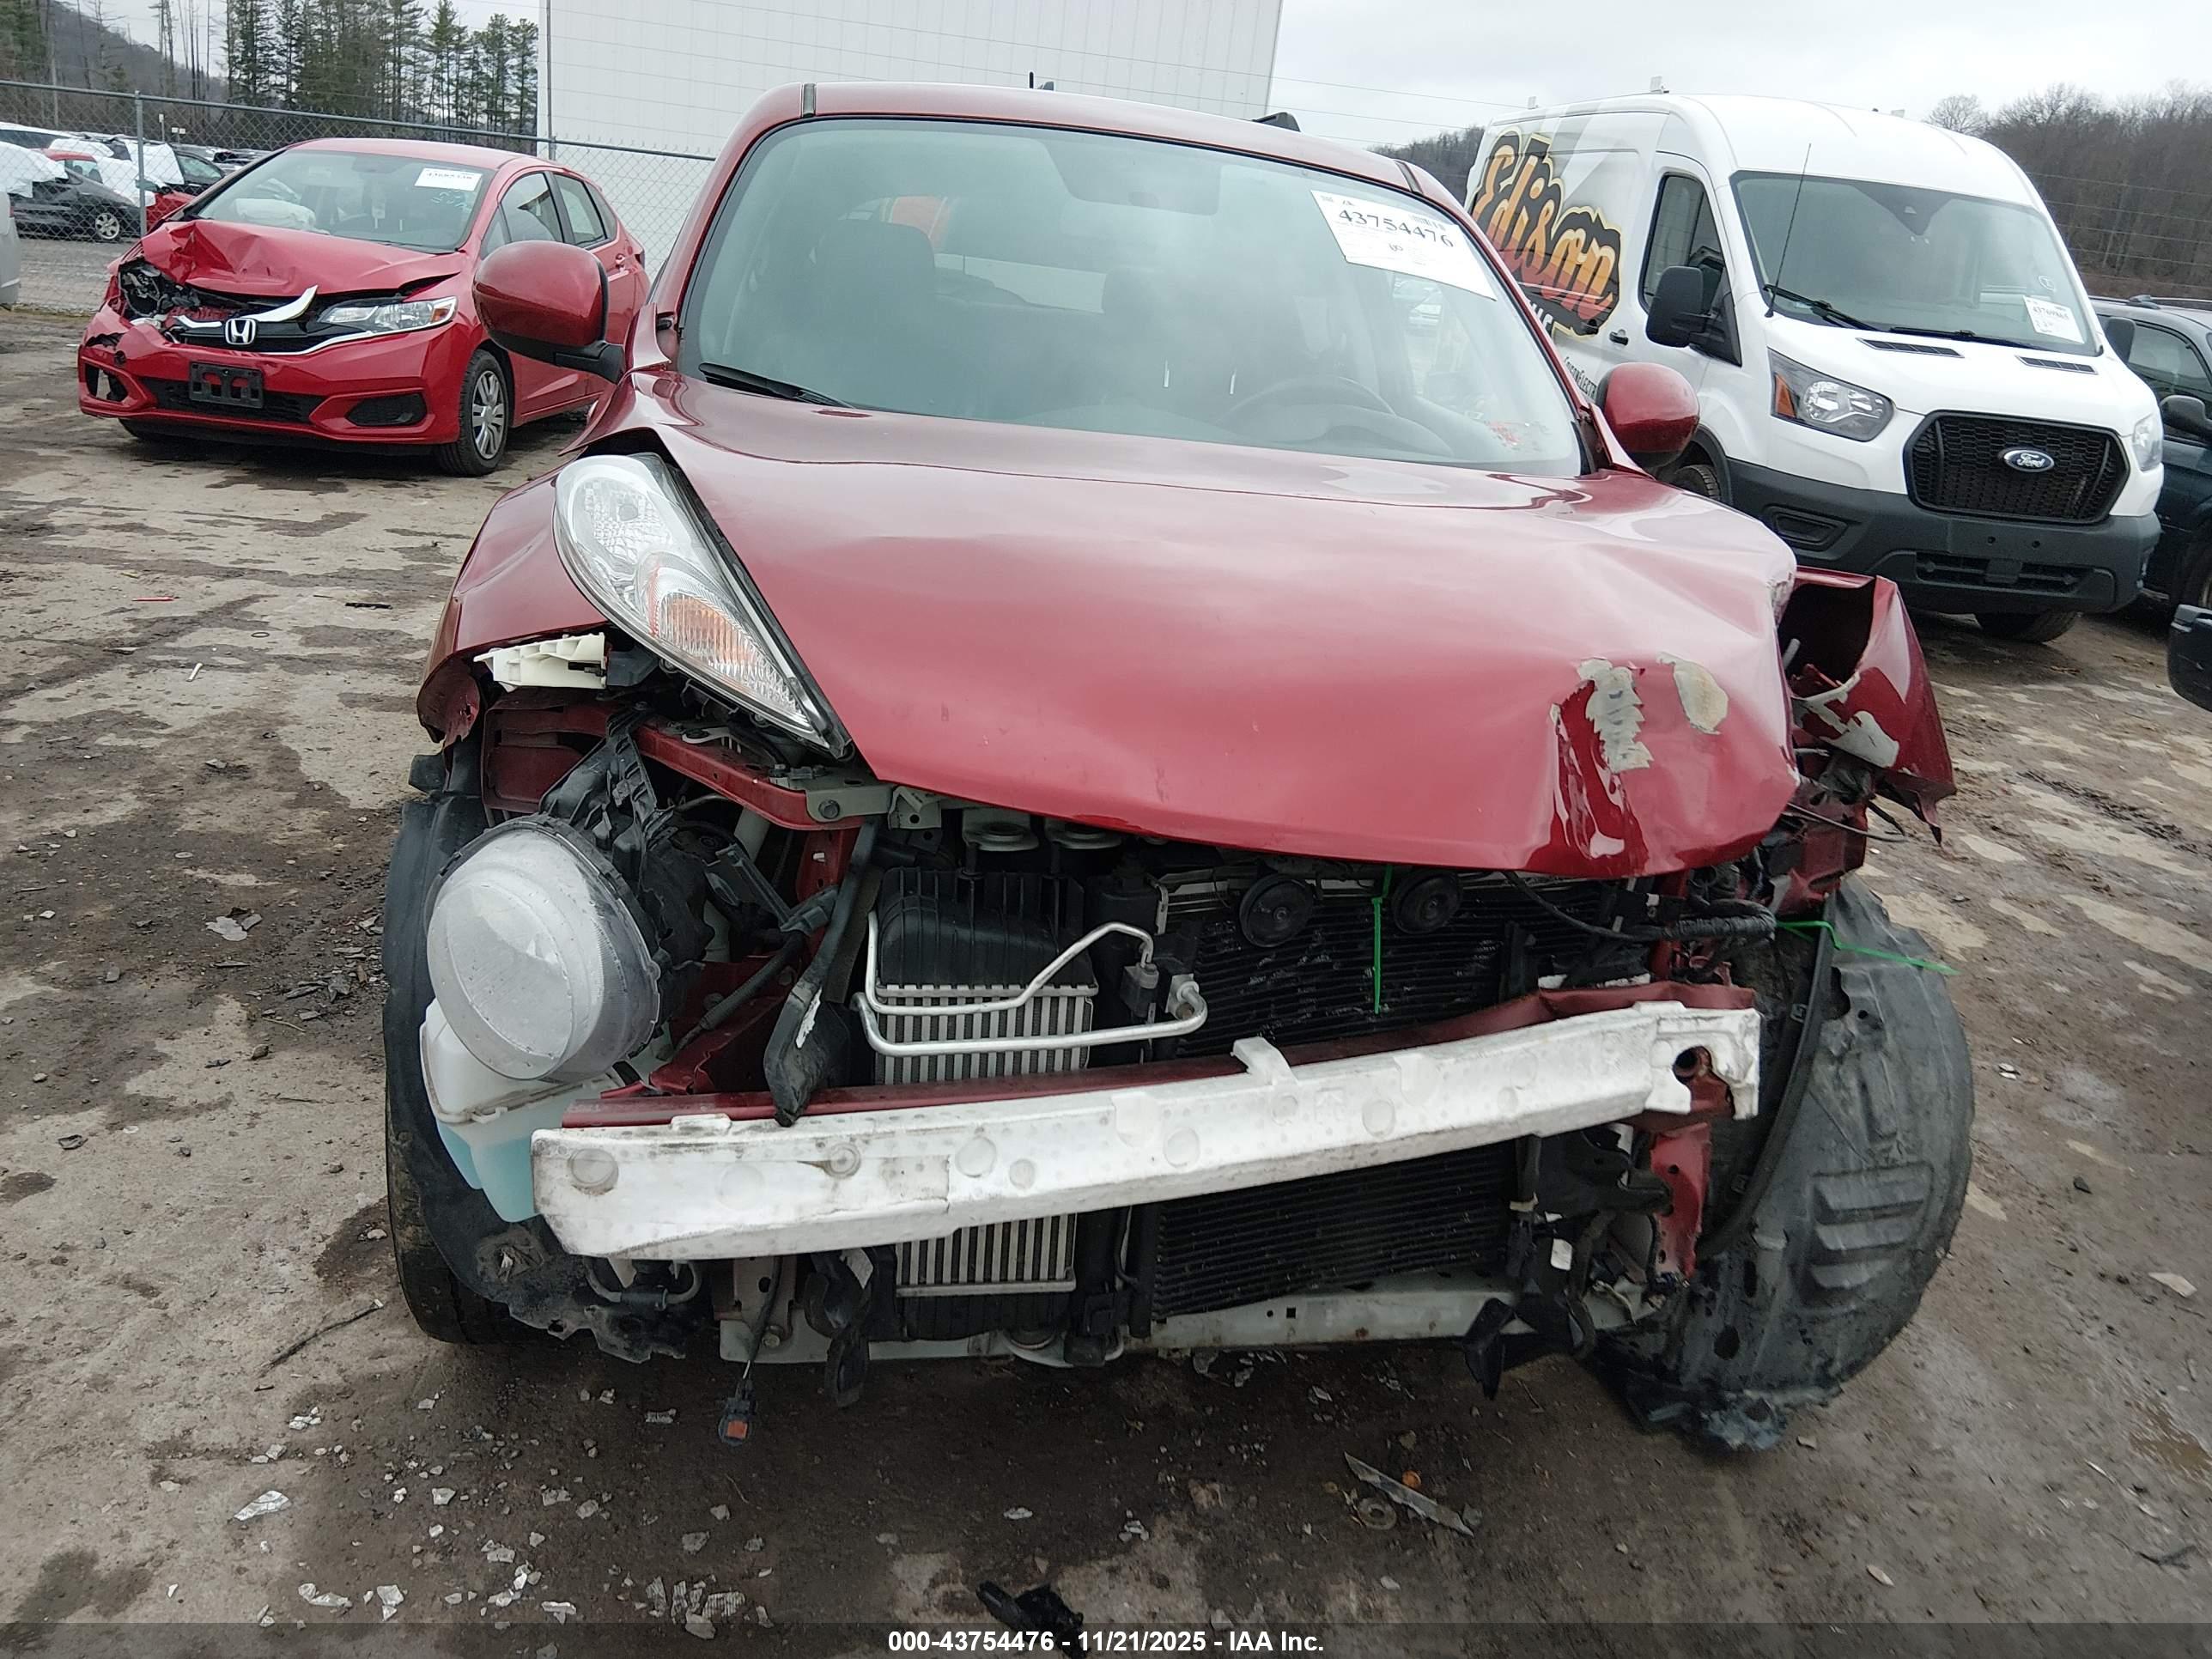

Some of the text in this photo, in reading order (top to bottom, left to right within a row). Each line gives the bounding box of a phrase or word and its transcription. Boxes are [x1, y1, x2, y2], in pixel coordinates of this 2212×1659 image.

[1339, 210, 1454, 248] 43754476
[1469, 143, 1615, 321] Edison
[2016, 453, 2045, 468] Ford
